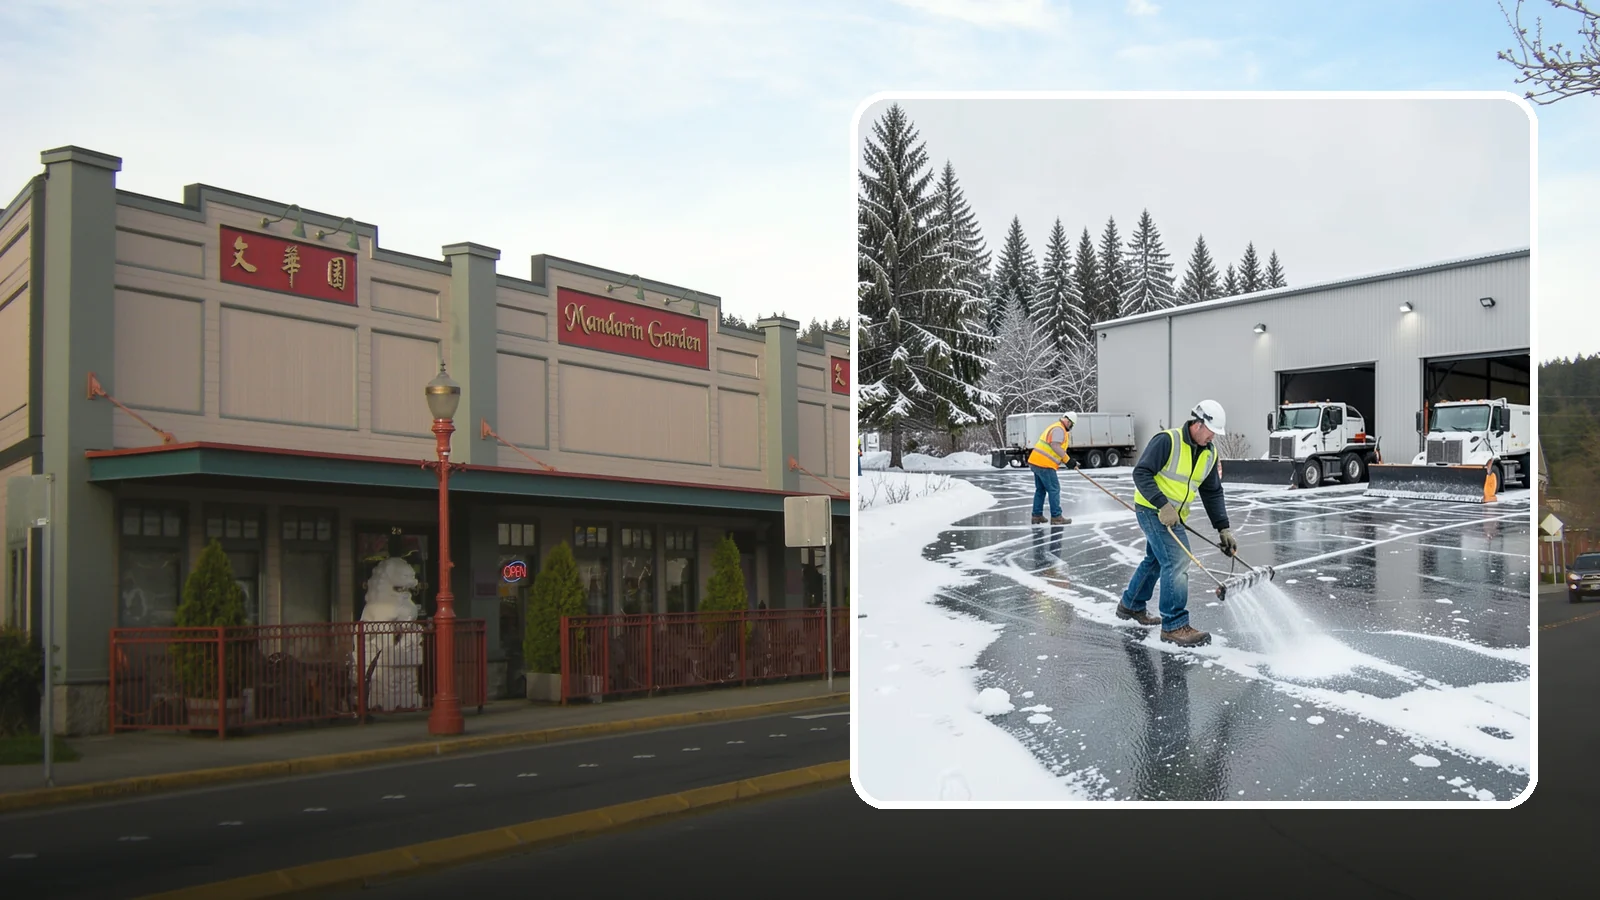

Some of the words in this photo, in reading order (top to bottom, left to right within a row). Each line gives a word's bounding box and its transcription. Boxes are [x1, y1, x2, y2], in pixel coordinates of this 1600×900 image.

[231, 235, 345, 291] 文華園
[564, 302, 644, 340] Mandarin
[648, 320, 701, 352] Garden
[503, 565, 527, 578] OPEN
